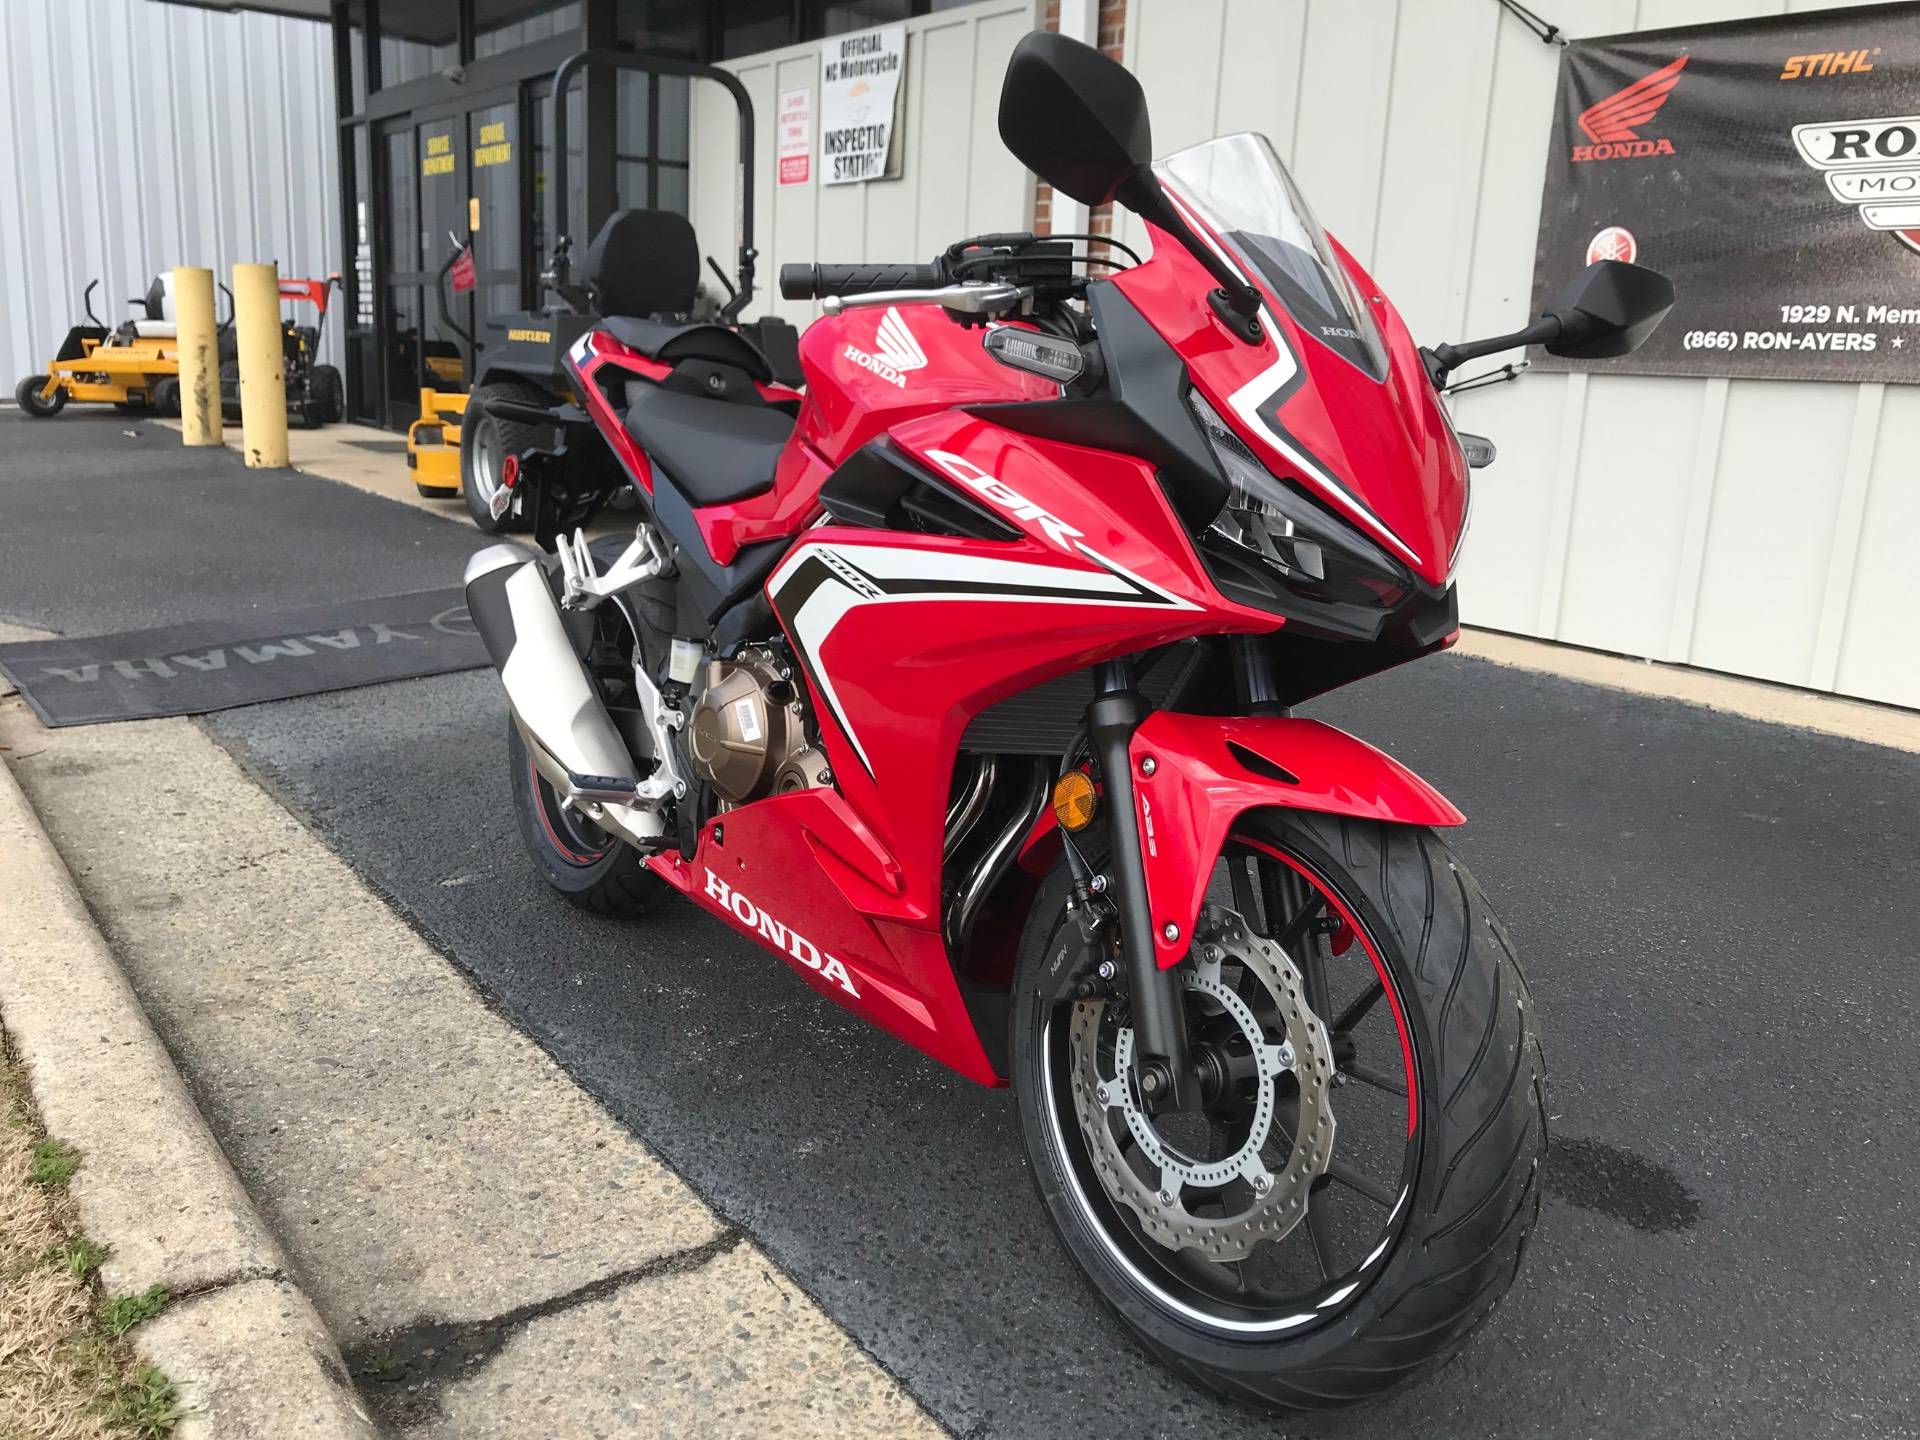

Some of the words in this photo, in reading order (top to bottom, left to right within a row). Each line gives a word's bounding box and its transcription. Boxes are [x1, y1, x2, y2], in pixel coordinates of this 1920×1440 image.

[841, 33, 882, 58] OFFICIAL
[826, 62, 838, 81] NC
[840, 51, 898, 79] Motorcycle
[1780, 49, 1875, 80] STIHL
[1571, 138, 1676, 162] HONDA
[1826, 126, 1920, 160] RO
[1859, 176, 1920, 192] MO
[1780, 305, 1831, 323] 1929
[1836, 305, 1860, 323] N.
[1866, 305, 1920, 323] Mem
[1683, 331, 1738, 351] (866)
[1742, 331, 1877, 351] RON-AYERS
[843, 345, 907, 388] HONDA
[924, 449, 1085, 552] CBR
[38, 623, 422, 683] YAMAHA
[1141, 792, 1158, 858] ABS
[704, 867, 861, 999] HONDA
